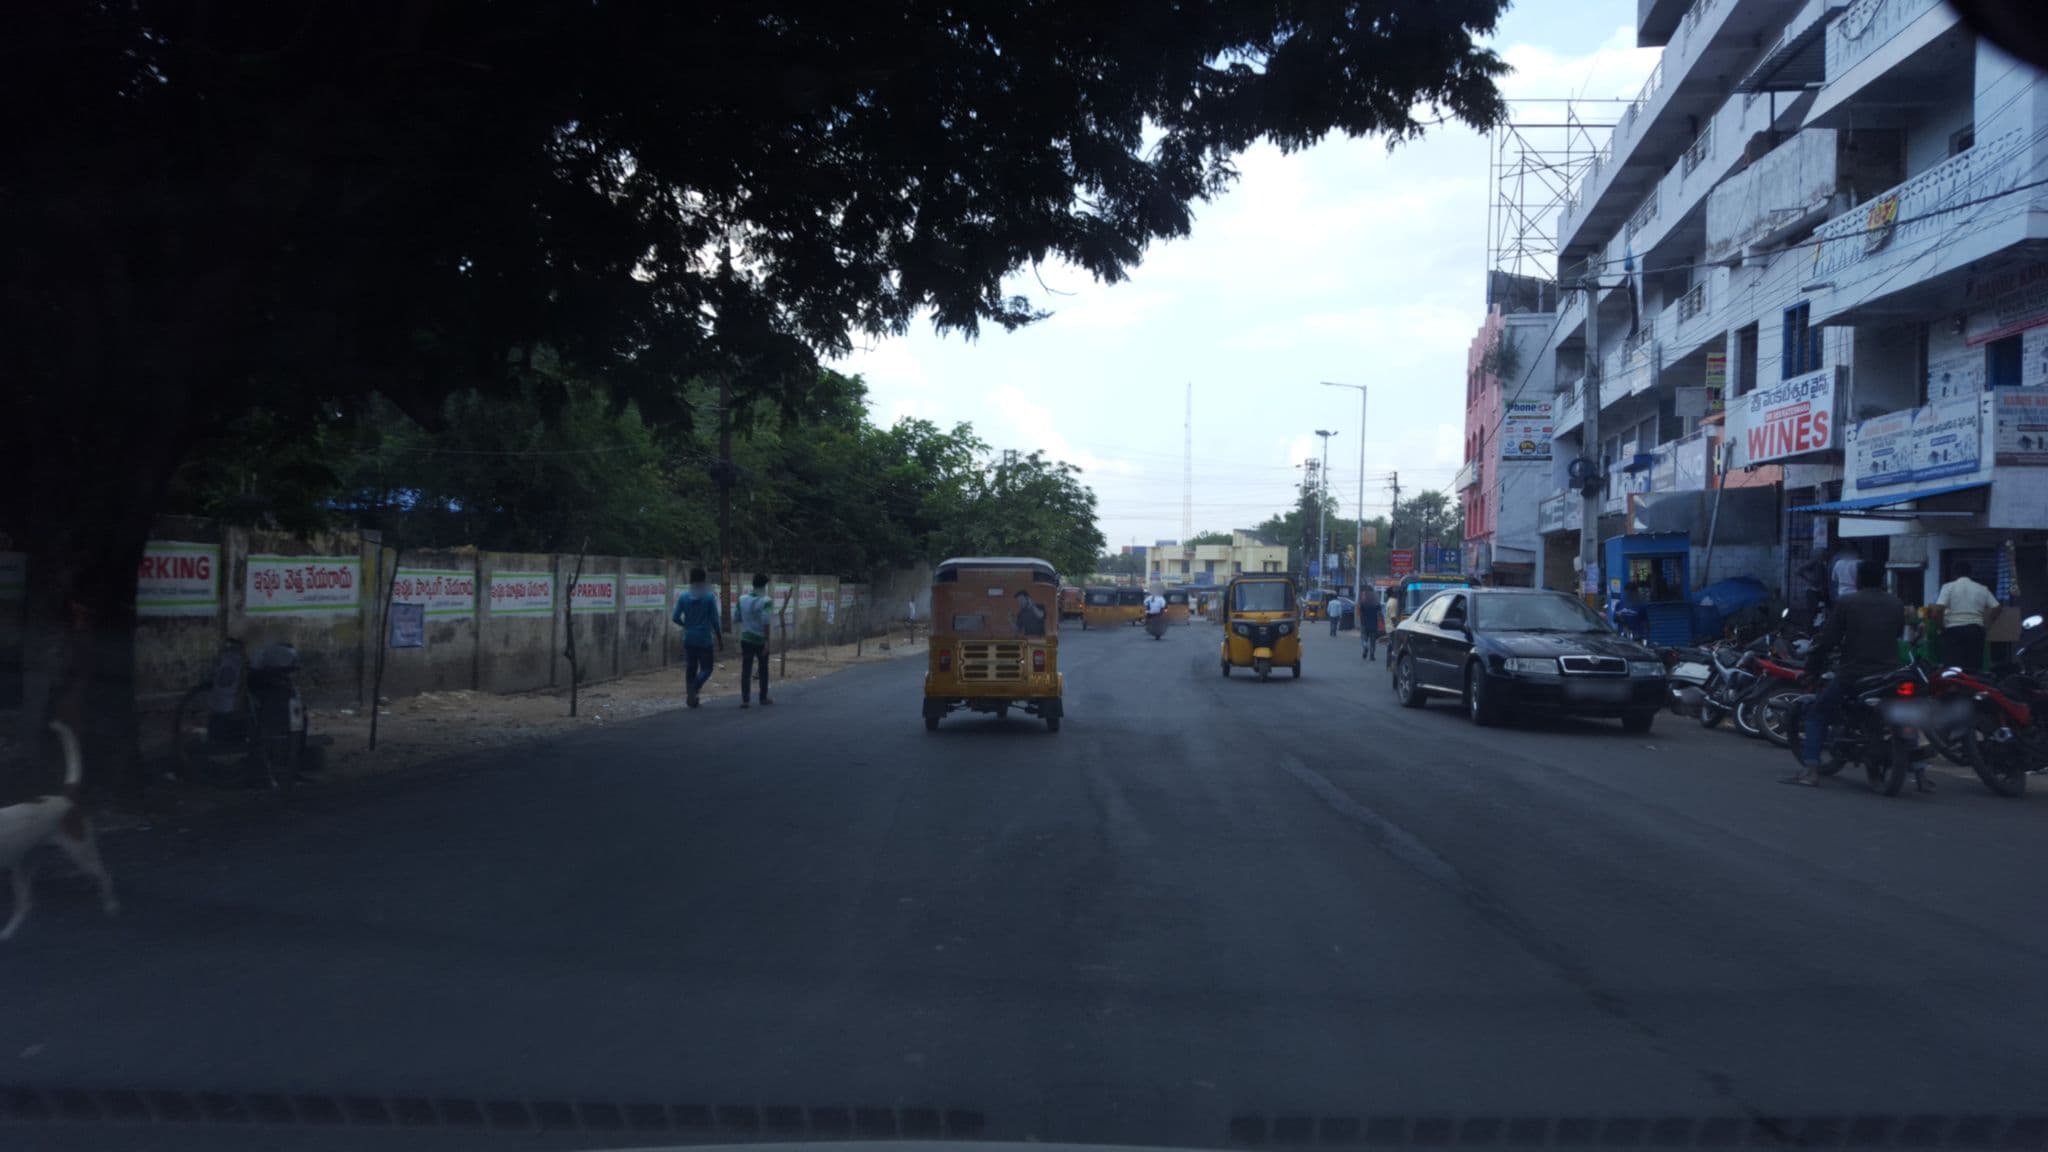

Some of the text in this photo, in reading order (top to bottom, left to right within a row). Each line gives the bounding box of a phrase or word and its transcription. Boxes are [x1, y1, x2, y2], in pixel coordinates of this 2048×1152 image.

[1747, 410, 1829, 461] WINES
[138, 556, 210, 580] RKING
[577, 583, 612, 598] PARKING
